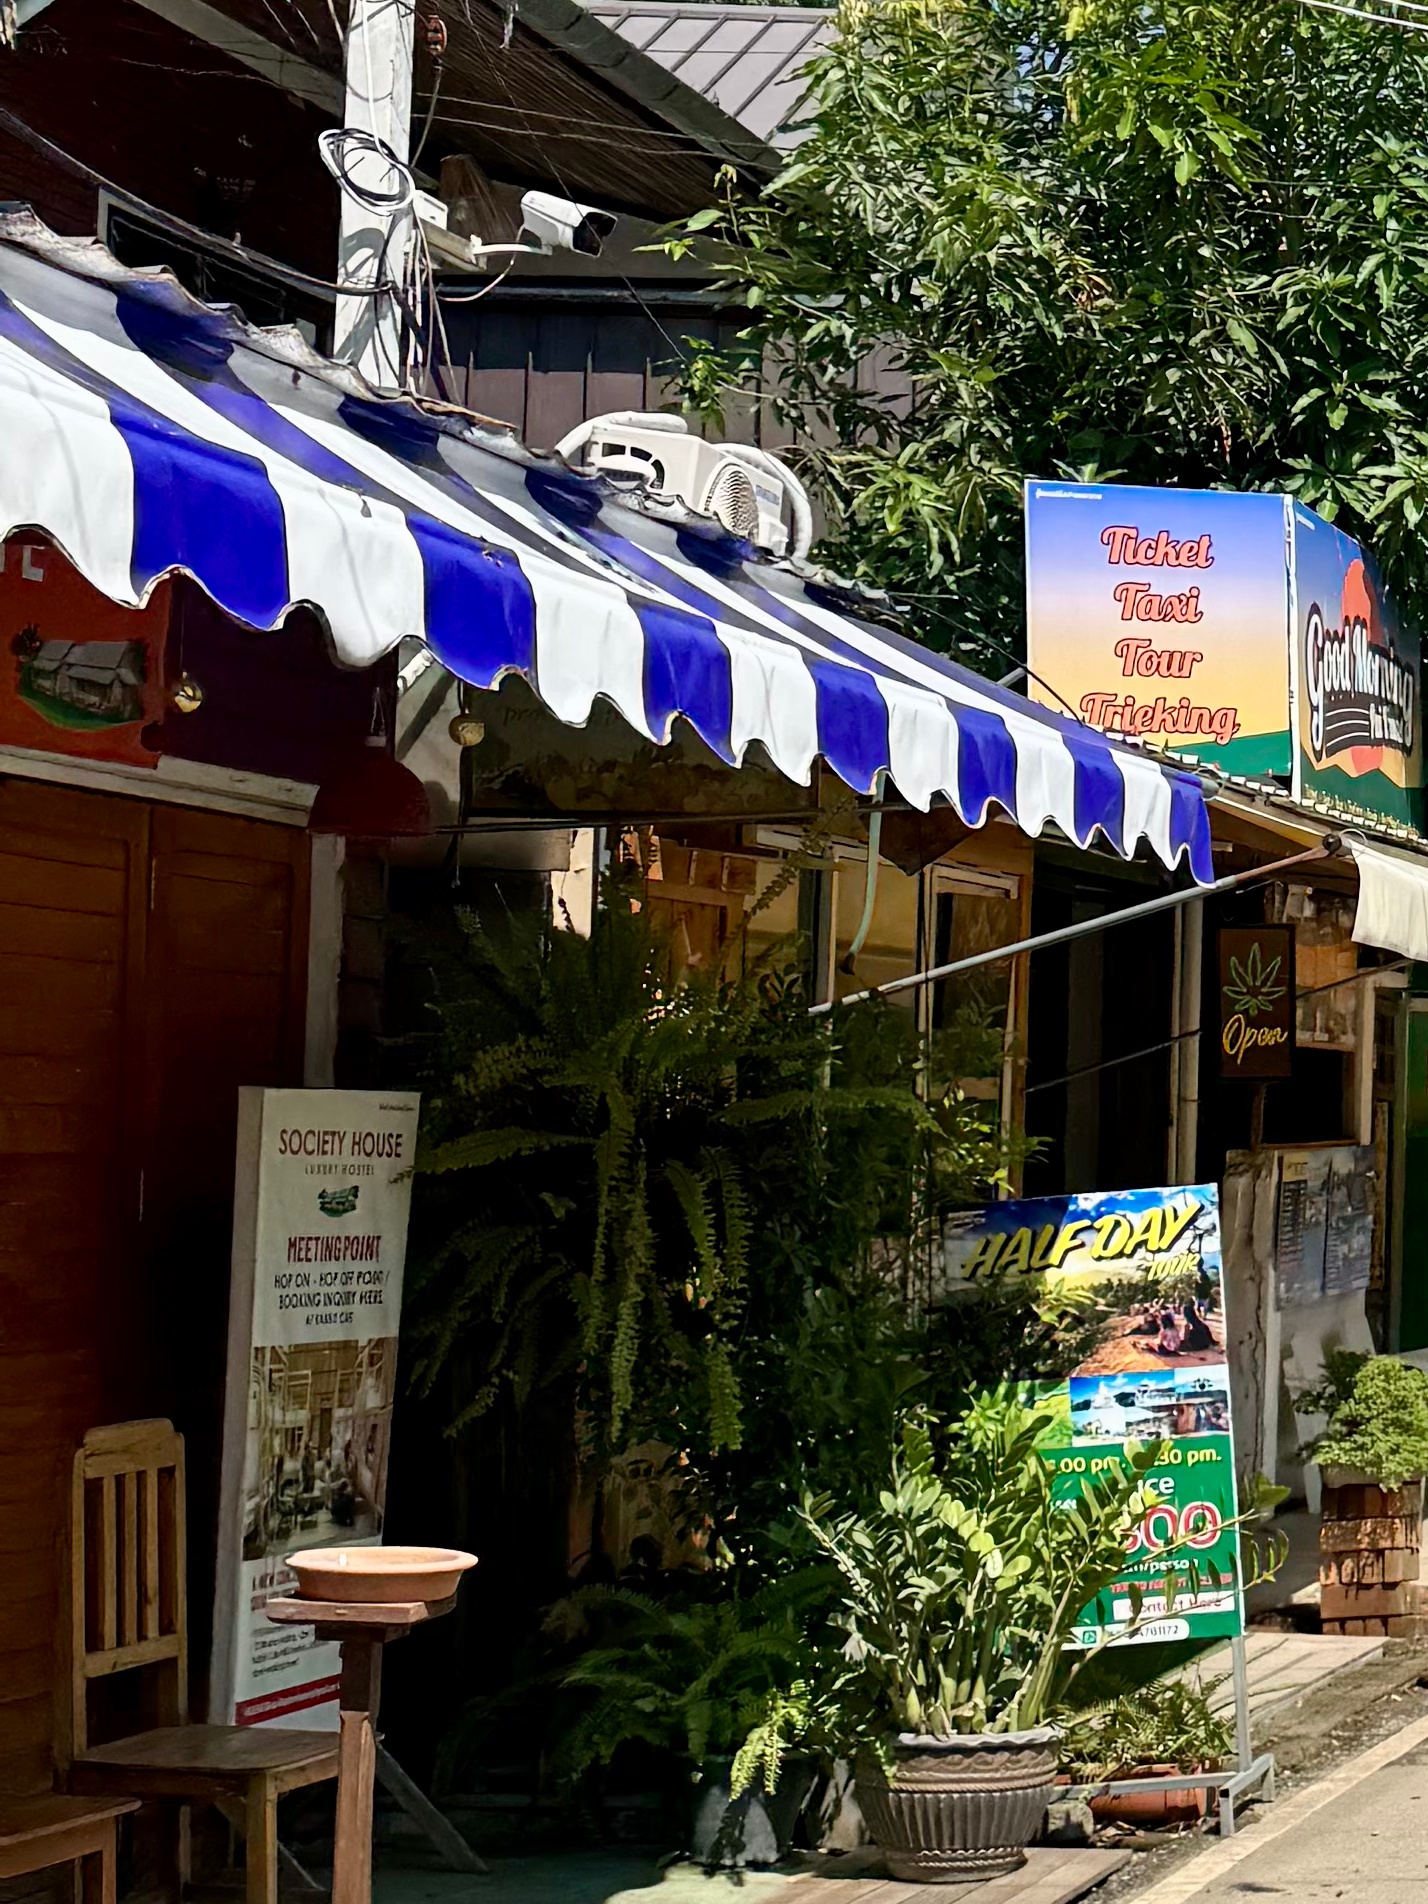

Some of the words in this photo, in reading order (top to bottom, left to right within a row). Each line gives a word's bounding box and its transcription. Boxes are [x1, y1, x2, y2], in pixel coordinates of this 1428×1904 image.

[1100, 525, 1214, 569] Ticket
[1113, 581, 1203, 624] Taxi
[1114, 637, 1203, 679] Tour
[1079, 691, 1241, 745] Trieking
[1222, 1013, 1288, 1064] Open
[279, 1128, 346, 1156] SOCIETY
[351, 1131, 403, 1158] HOUSE
[287, 1235, 341, 1264] MEETING
[342, 1234, 382, 1263] POINT
[963, 1219, 1092, 1280] HALF
[1090, 1199, 1204, 1259] DAY
[1046, 1457, 1086, 1474] .00
[1187, 1448, 1222, 1467] pm.
